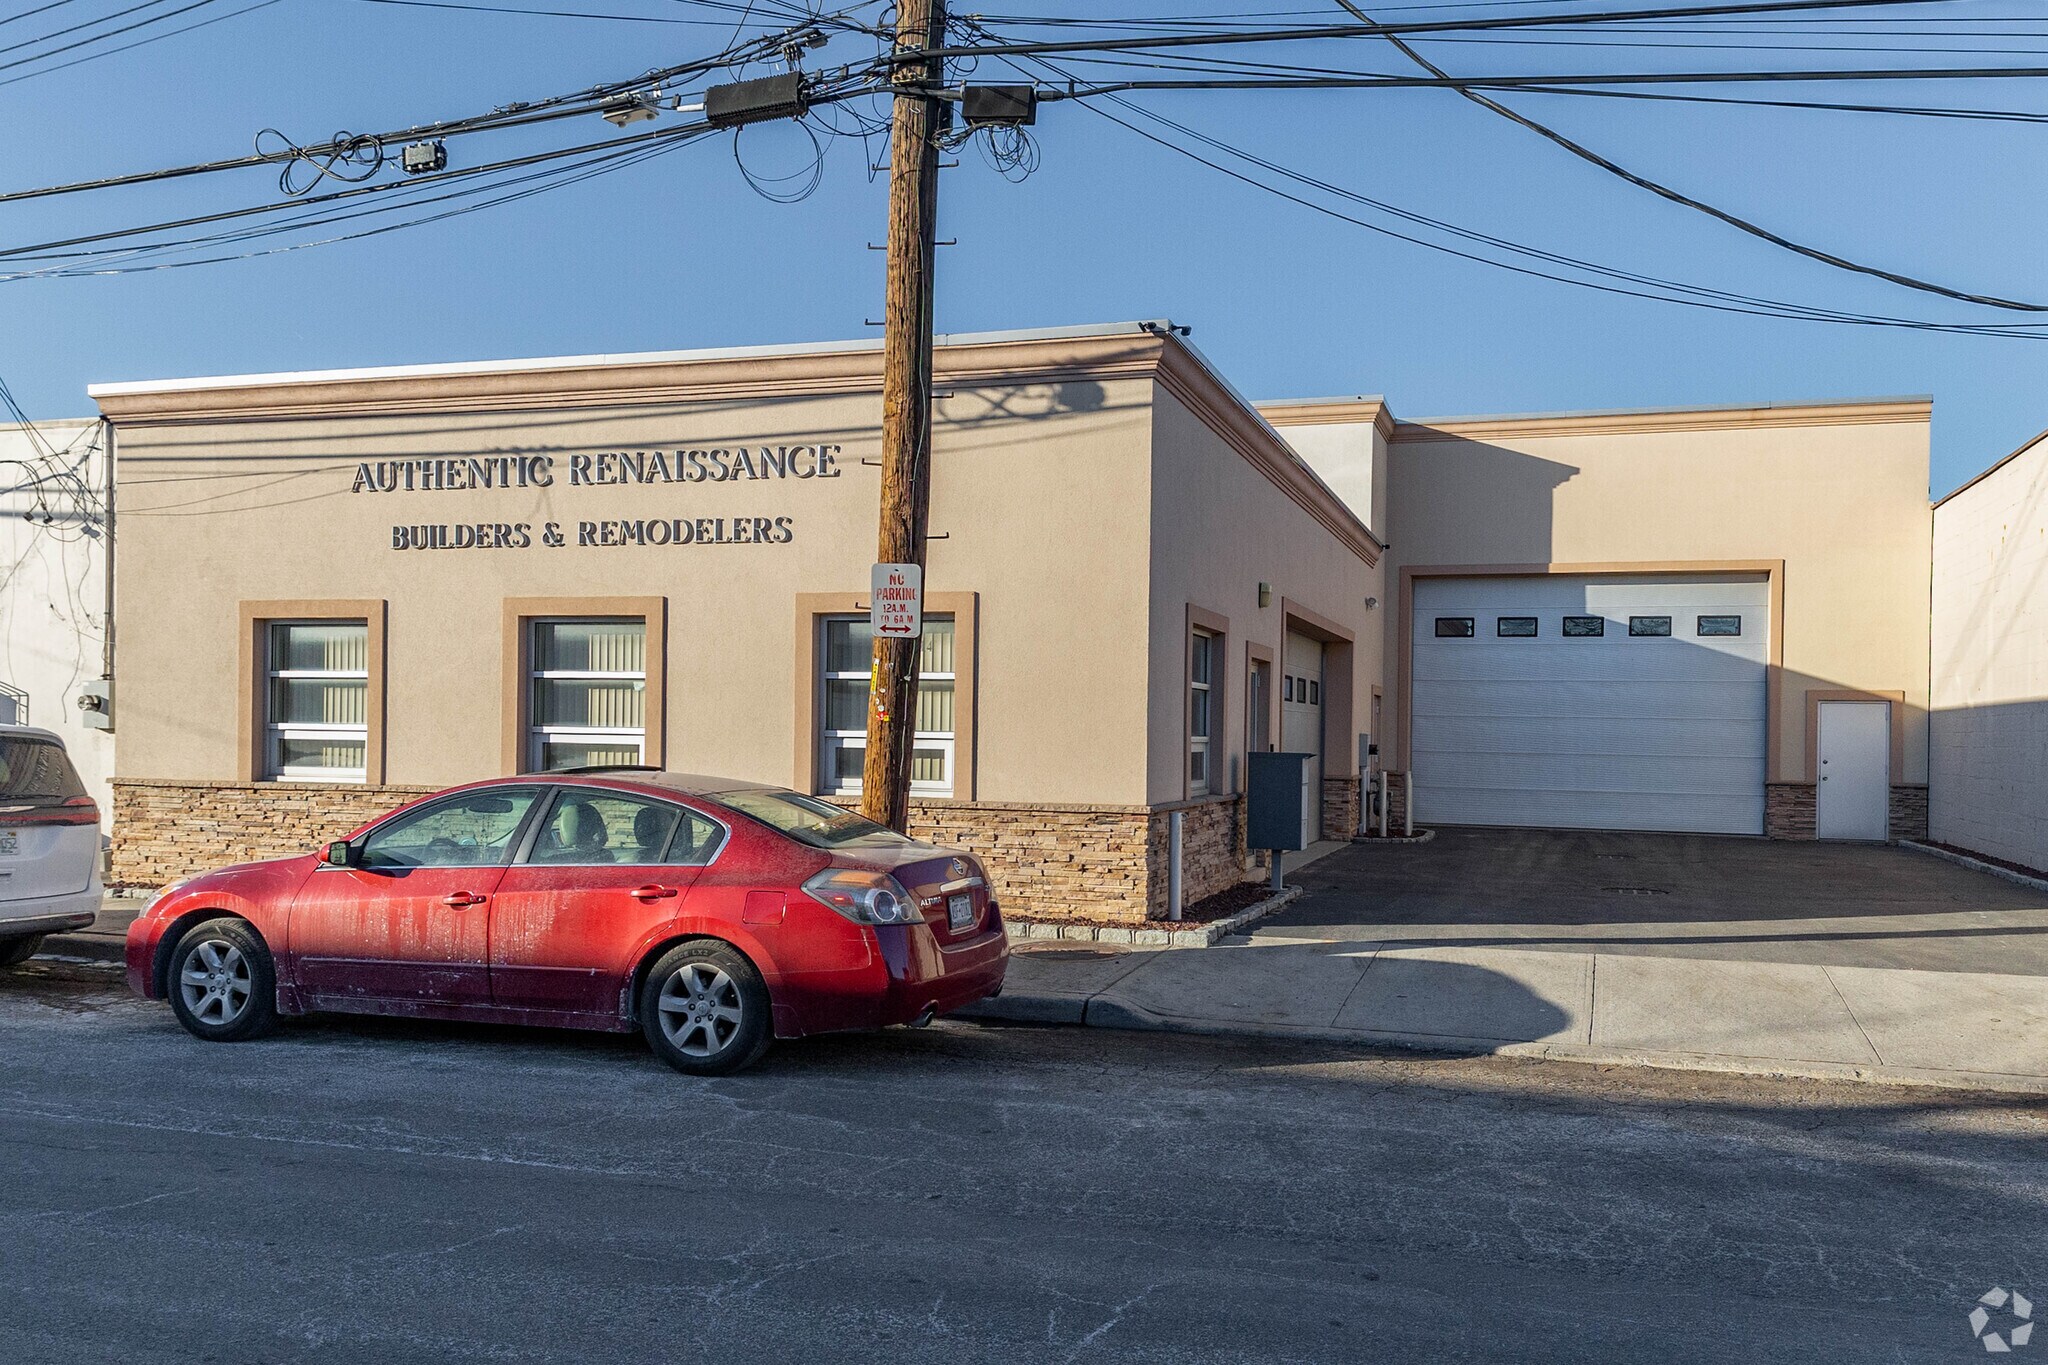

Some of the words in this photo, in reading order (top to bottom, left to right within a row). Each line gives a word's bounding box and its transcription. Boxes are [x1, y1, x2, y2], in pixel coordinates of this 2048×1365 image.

[351, 455, 554, 493] AUTHENTIC
[568, 445, 842, 486] RENAISSANCE
[391, 522, 531, 551] BUILDERS
[542, 521, 566, 548] &
[576, 516, 794, 548] REMODELERS
